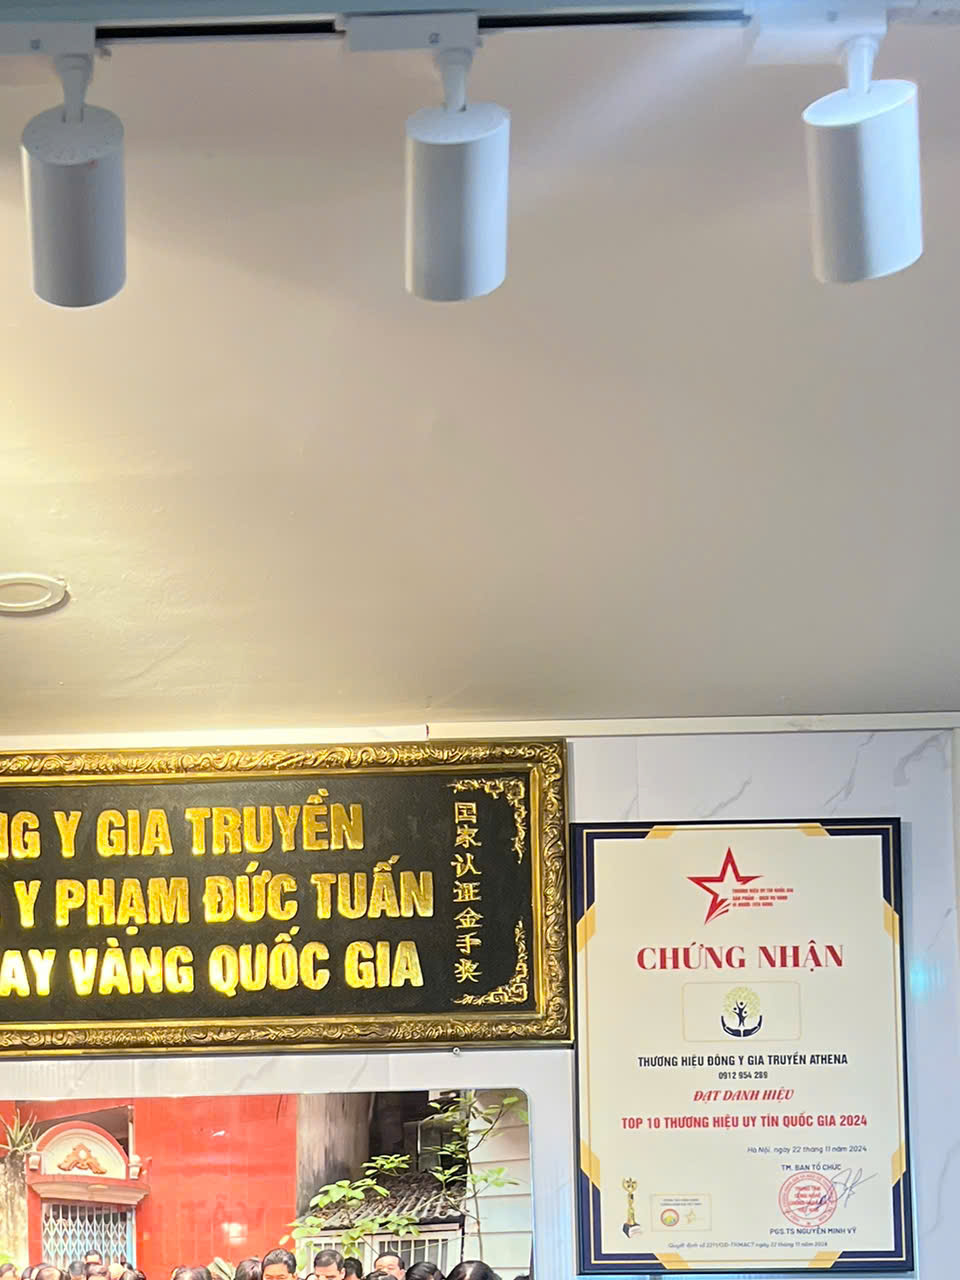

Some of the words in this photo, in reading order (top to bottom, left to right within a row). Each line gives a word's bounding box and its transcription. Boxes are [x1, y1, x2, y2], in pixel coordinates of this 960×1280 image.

[54, 810, 82, 858] Y
[97, 809, 173, 857] GIA
[185, 788, 364, 856] TRUYỀN
[14, 880, 41, 928] Y
[55, 877, 189, 935] PHẠM
[203, 860, 298, 923] ĐỨC
[310, 855, 434, 919] TUẤN
[69, 938, 194, 995] VÀNG
[208, 925, 330, 997] QUỐC
[345, 941, 424, 989] GIA
[637, 941, 745, 970] CHỨNG
[758, 939, 843, 972] NHẬN
[638, 1055, 678, 1067] THƯƠNG
[681, 1054, 704, 1069] HIỆU
[707, 1054, 735, 1066] ĐÔNG
[738, 1056, 745, 1066] Y
[748, 1055, 764, 1066] GIA
[809, 1054, 848, 1065] ATHENA
[718, 1071, 737, 1079] 0912
[693, 1090, 721, 1104] ĐẠT
[722, 1089, 760, 1101] DANH
[762, 1087, 794, 1103] HIỆU
[621, 1117, 643, 1129] TOP
[647, 1117, 660, 1128] 10
[664, 1116, 709, 1128] THƯƠNG
[713, 1113, 739, 1130] HIỆU
[743, 1116, 756, 1127] UY
[761, 1113, 779, 1127] TÍN
[783, 1111, 813, 1128] QUỐC
[817, 1115, 836, 1126] GIA
[840, 1114, 867, 1126] 2024
